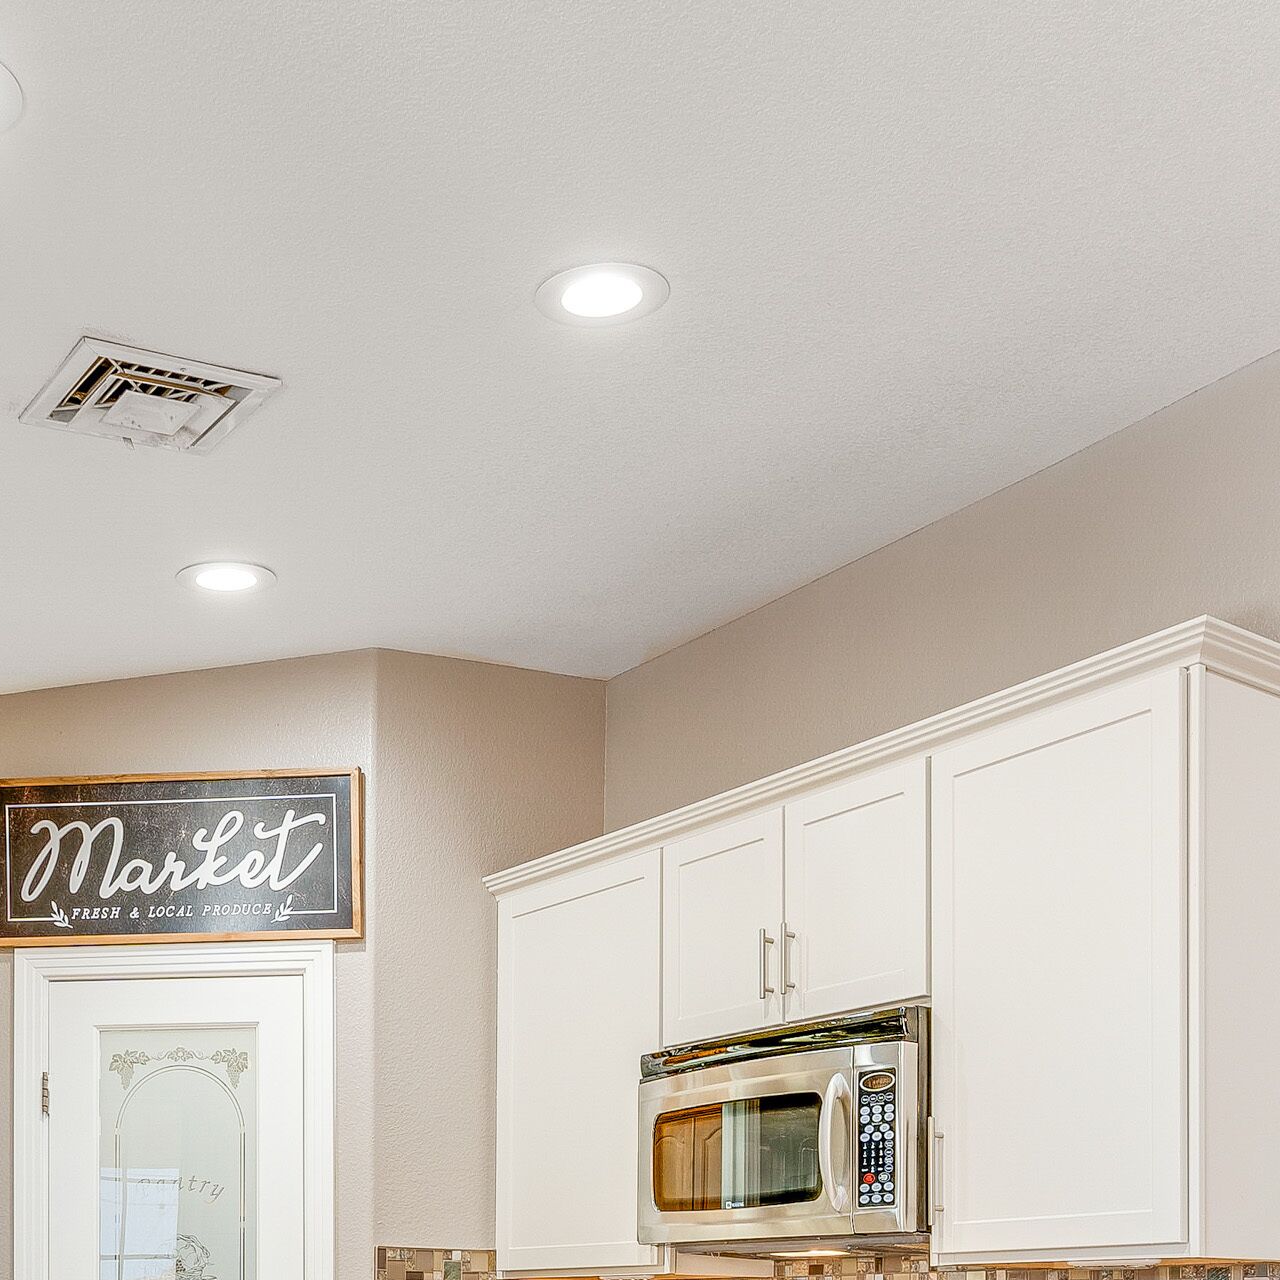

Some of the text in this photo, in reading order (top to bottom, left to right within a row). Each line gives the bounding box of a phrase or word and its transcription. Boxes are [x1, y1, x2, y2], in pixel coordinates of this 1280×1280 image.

[21, 809, 326, 902] Market
[71, 903, 273, 920] FRESH & LOCAL PRODUCE
